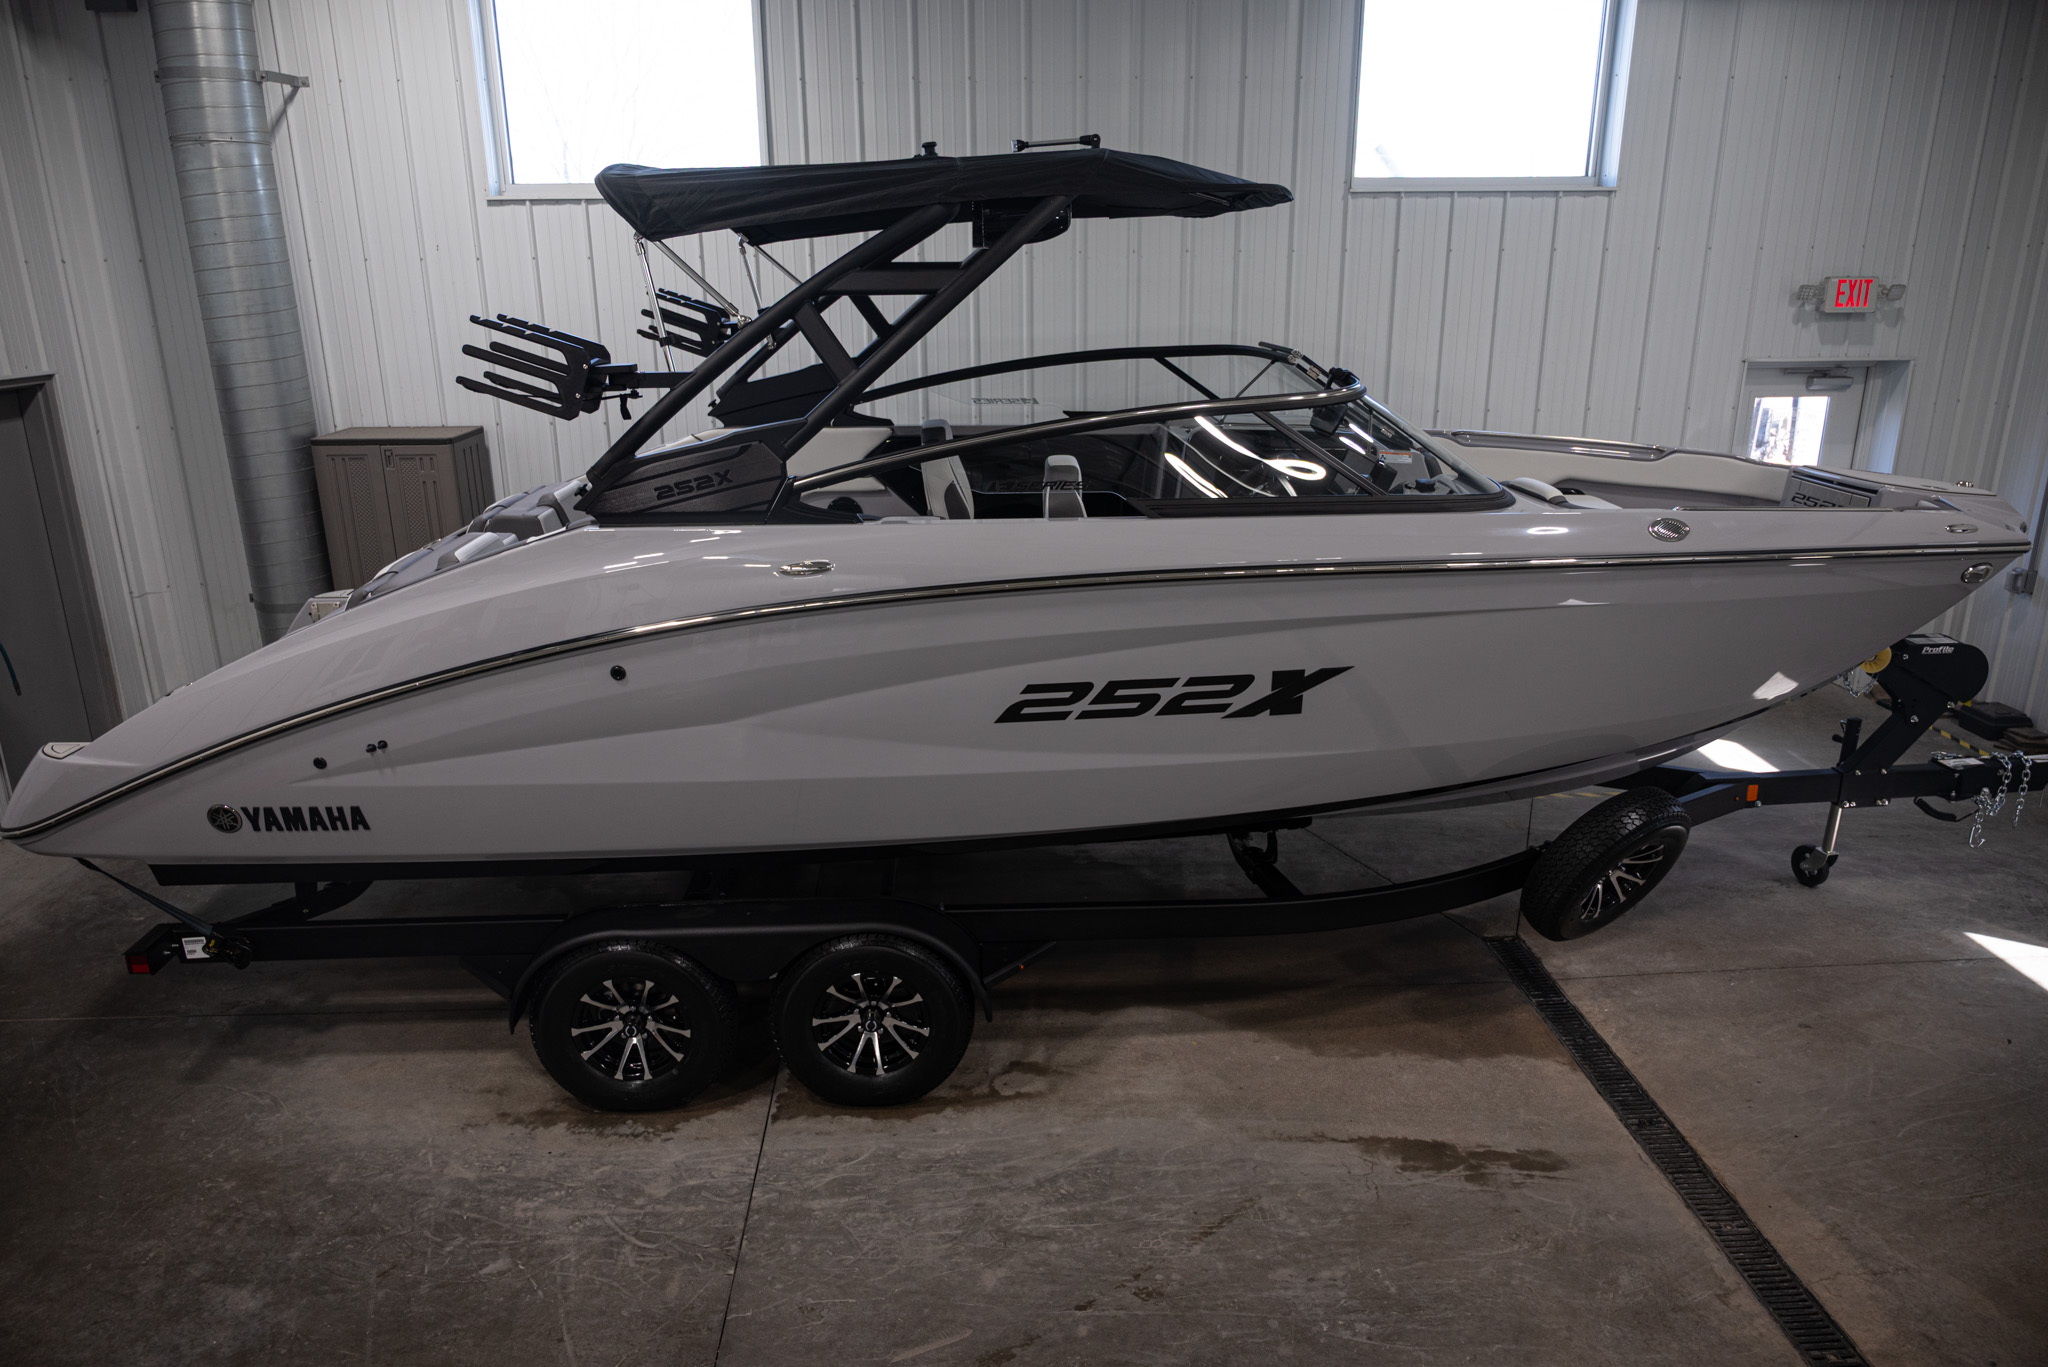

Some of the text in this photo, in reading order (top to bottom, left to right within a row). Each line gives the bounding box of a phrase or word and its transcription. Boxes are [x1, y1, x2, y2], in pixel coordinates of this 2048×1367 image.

[1835, 279, 1873, 307] EXIT
[653, 469, 734, 501] 252X
[1791, 492, 1845, 507] 252
[994, 666, 1354, 723] 252X
[240, 806, 371, 832] YAMAHA
